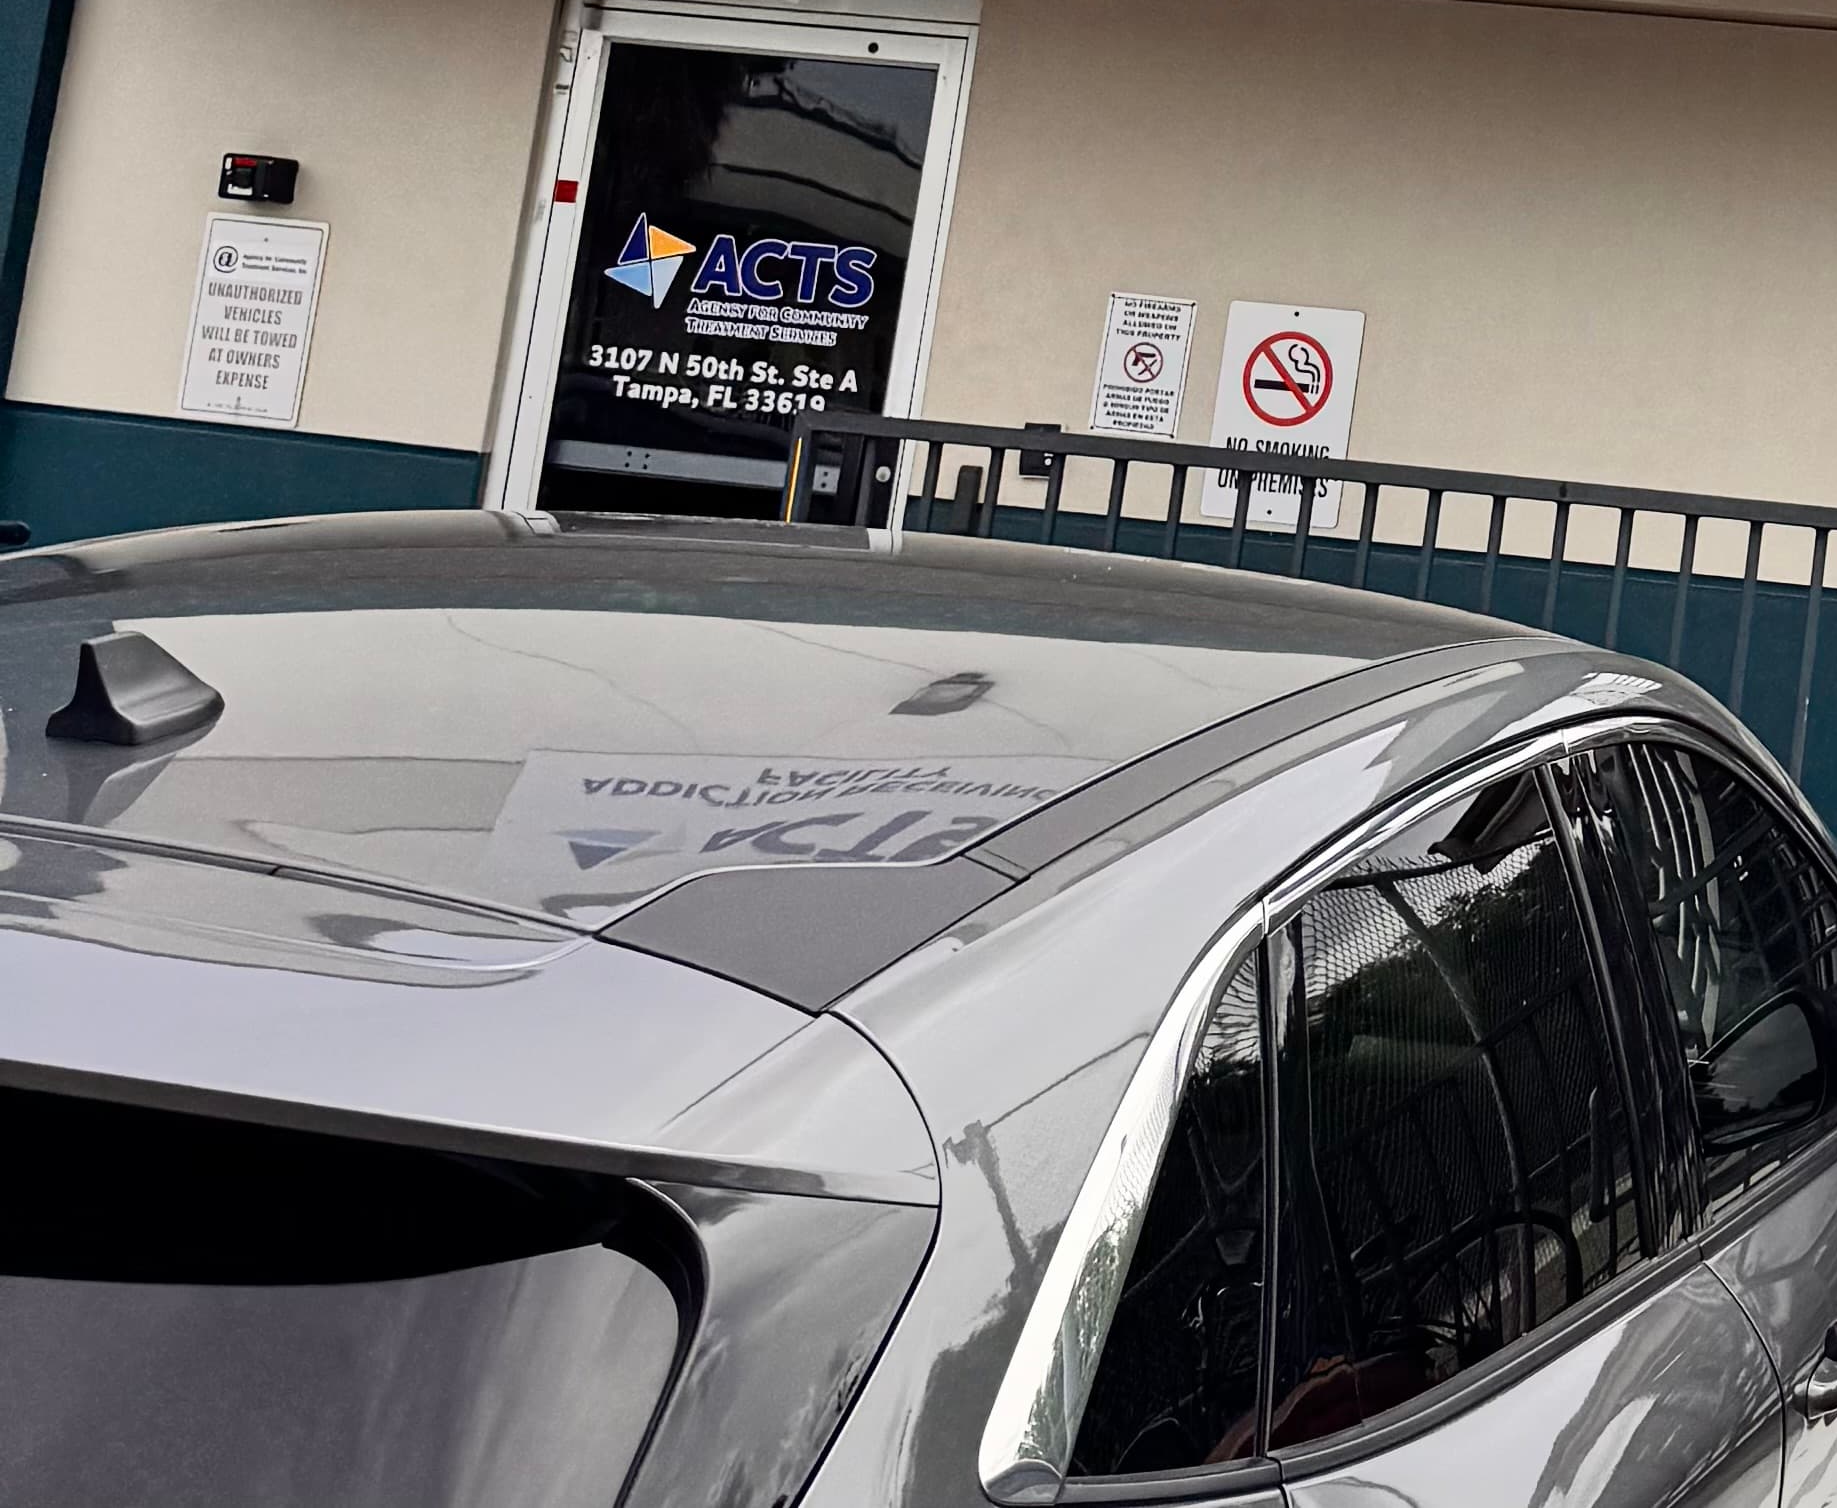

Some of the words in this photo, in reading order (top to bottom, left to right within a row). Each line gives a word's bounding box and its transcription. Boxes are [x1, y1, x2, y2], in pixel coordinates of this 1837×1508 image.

[691, 234, 877, 308] ACTS
[208, 282, 303, 305] UNAUTHORIZED
[224, 305, 283, 325] VEHICLES
[201, 325, 231, 342] WILL
[234, 328, 250, 344] BE
[253, 330, 298, 349] TOWED
[208, 347, 224, 363] AT
[226, 349, 280, 369] OWNERS
[588, 345, 653, 370] 3107
[658, 352, 679, 375] N
[685, 355, 744, 382] 50th
[750, 361, 785, 386] St.
[791, 365, 834, 391] Ste
[839, 370, 858, 393] A
[215, 369, 269, 390] EXPENSE
[612, 375, 699, 409] Tampa,
[706, 385, 738, 409] FL
[744, 389, 826, 415] 33619
